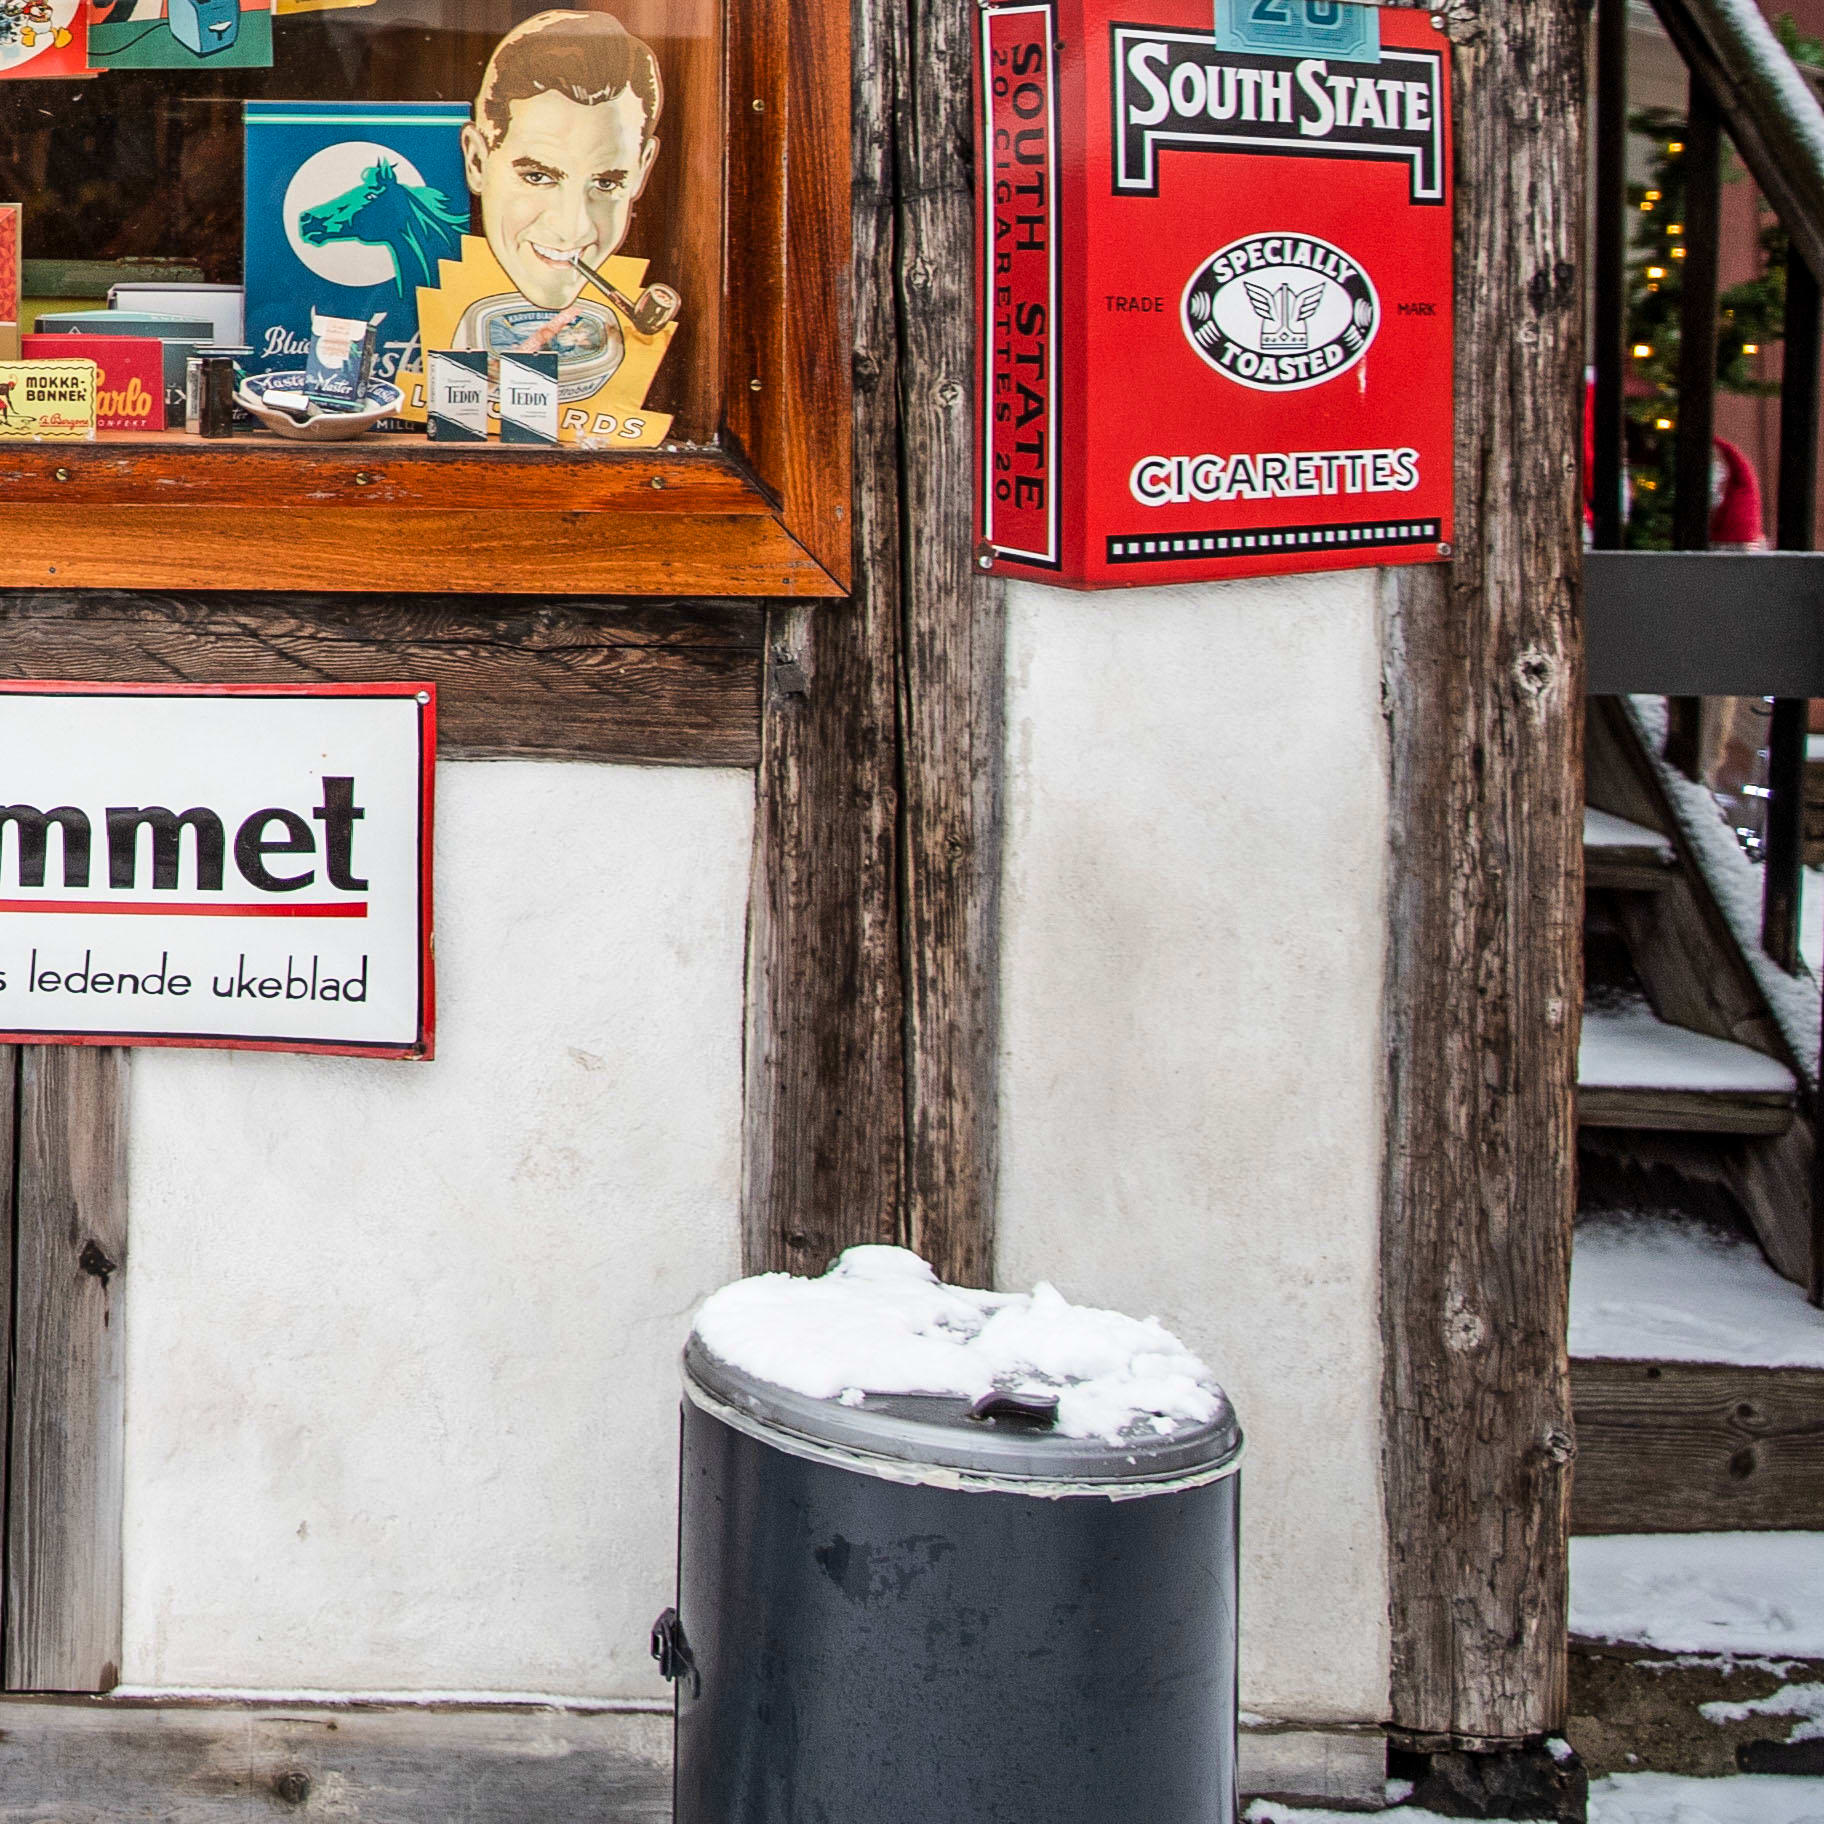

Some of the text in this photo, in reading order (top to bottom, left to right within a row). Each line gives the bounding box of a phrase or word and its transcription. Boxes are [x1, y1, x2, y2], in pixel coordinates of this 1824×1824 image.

[1128, 41, 1433, 138] SOUTH STATE
[992, 46, 1013, 503] 20 CIGARETTES 20
[1012, 41, 1047, 511] SOUTH STATE
[1212, 237, 1357, 285] SPECIALLY
[1105, 294, 1164, 314] TRADE
[1397, 301, 1437, 318] MARK
[1220, 343, 1347, 384] TOASTED
[25, 375, 86, 389] MOKKA-
[25, 388, 87, 402] BØNNER
[444, 384, 482, 404] TEDDY
[508, 386, 549, 406] TEDDY
[97, 419, 148, 427] ONFEKT
[1129, 447, 1421, 507] CIGARETTES
[28, 948, 194, 998] ledende
[211, 954, 368, 1004] ukeblad
